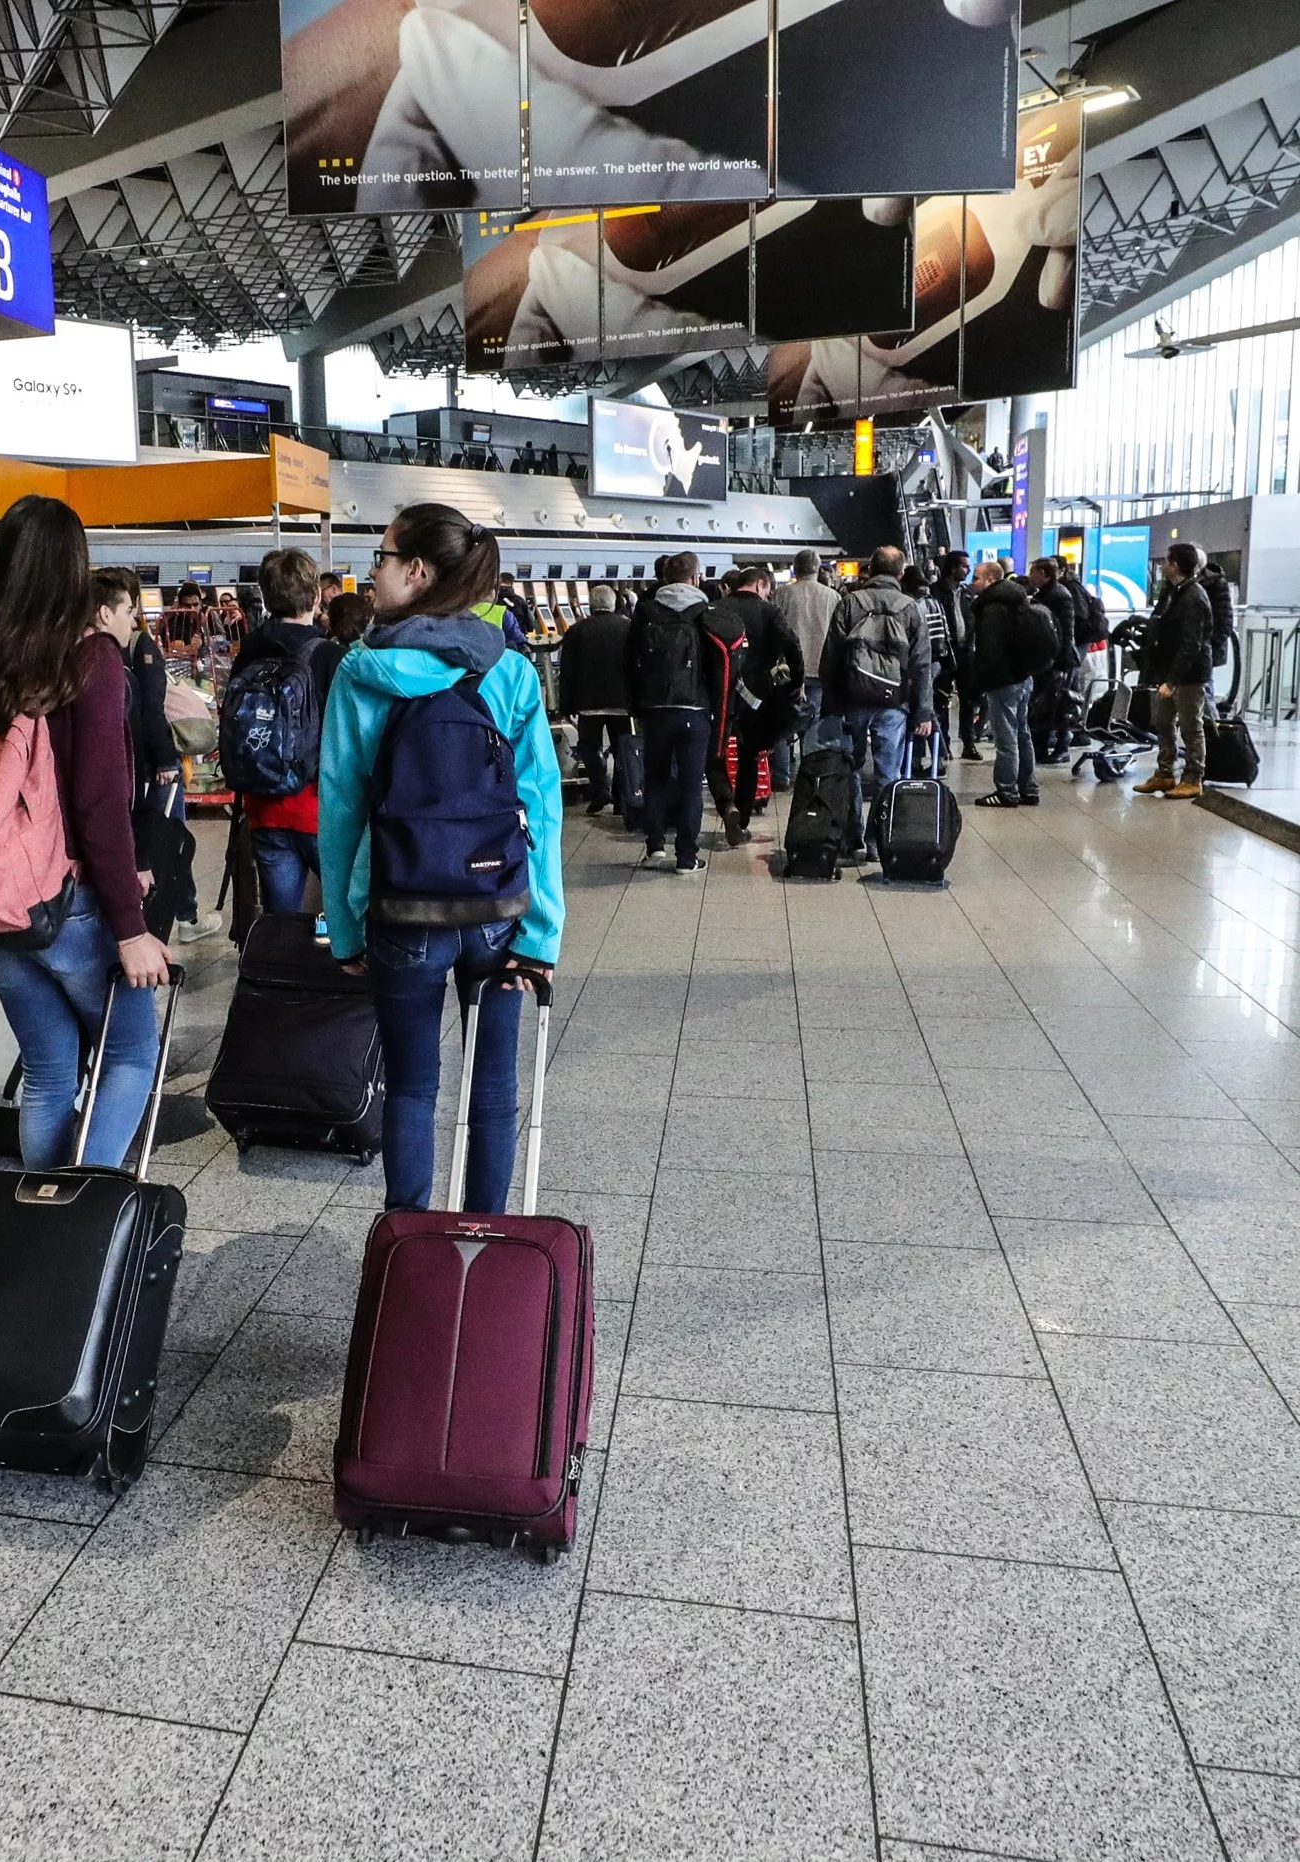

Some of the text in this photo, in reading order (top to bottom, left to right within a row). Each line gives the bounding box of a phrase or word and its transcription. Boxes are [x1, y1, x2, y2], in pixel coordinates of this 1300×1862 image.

[1023, 141, 1052, 167] EY
[319, 157, 761, 186] The better the question. The better the answer. The better the world works.
[20, 208, 32, 224] hall
[483, 347, 496, 355] The
[496, 345, 517, 353] better
[518, 343, 529, 351] the
[530, 341, 561, 350] question.
[576, 337, 598, 345] better
[619, 332, 645, 340] answer.
[662, 328, 684, 336] better
[699, 323, 720, 332] world
[721, 321, 745, 330] works.
[13, 378, 82, 398] Galaxy S9+
[471, 861, 501, 869] EASTPAK
